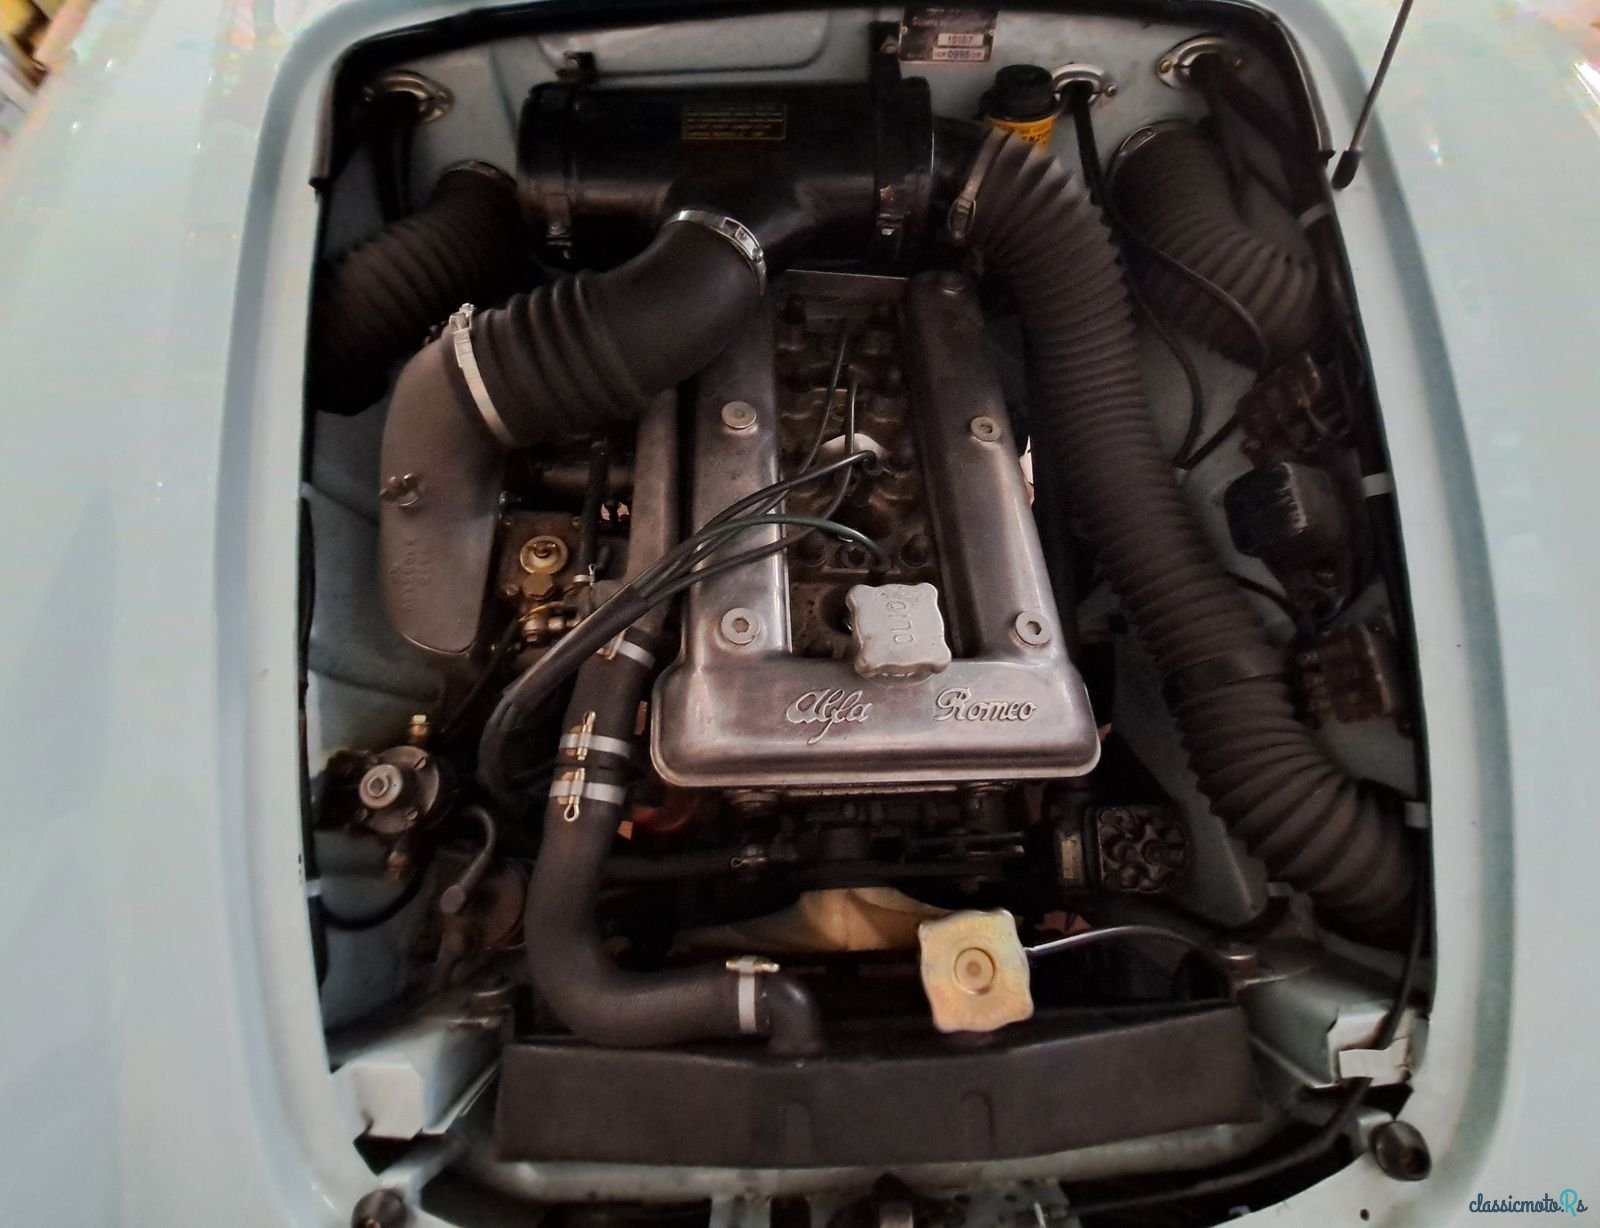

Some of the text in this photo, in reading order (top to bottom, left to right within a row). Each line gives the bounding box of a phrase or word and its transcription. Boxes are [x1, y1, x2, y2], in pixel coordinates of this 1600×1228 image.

[887, 599, 913, 645] OLIO
[786, 687, 1037, 746] Alfa Romeo
